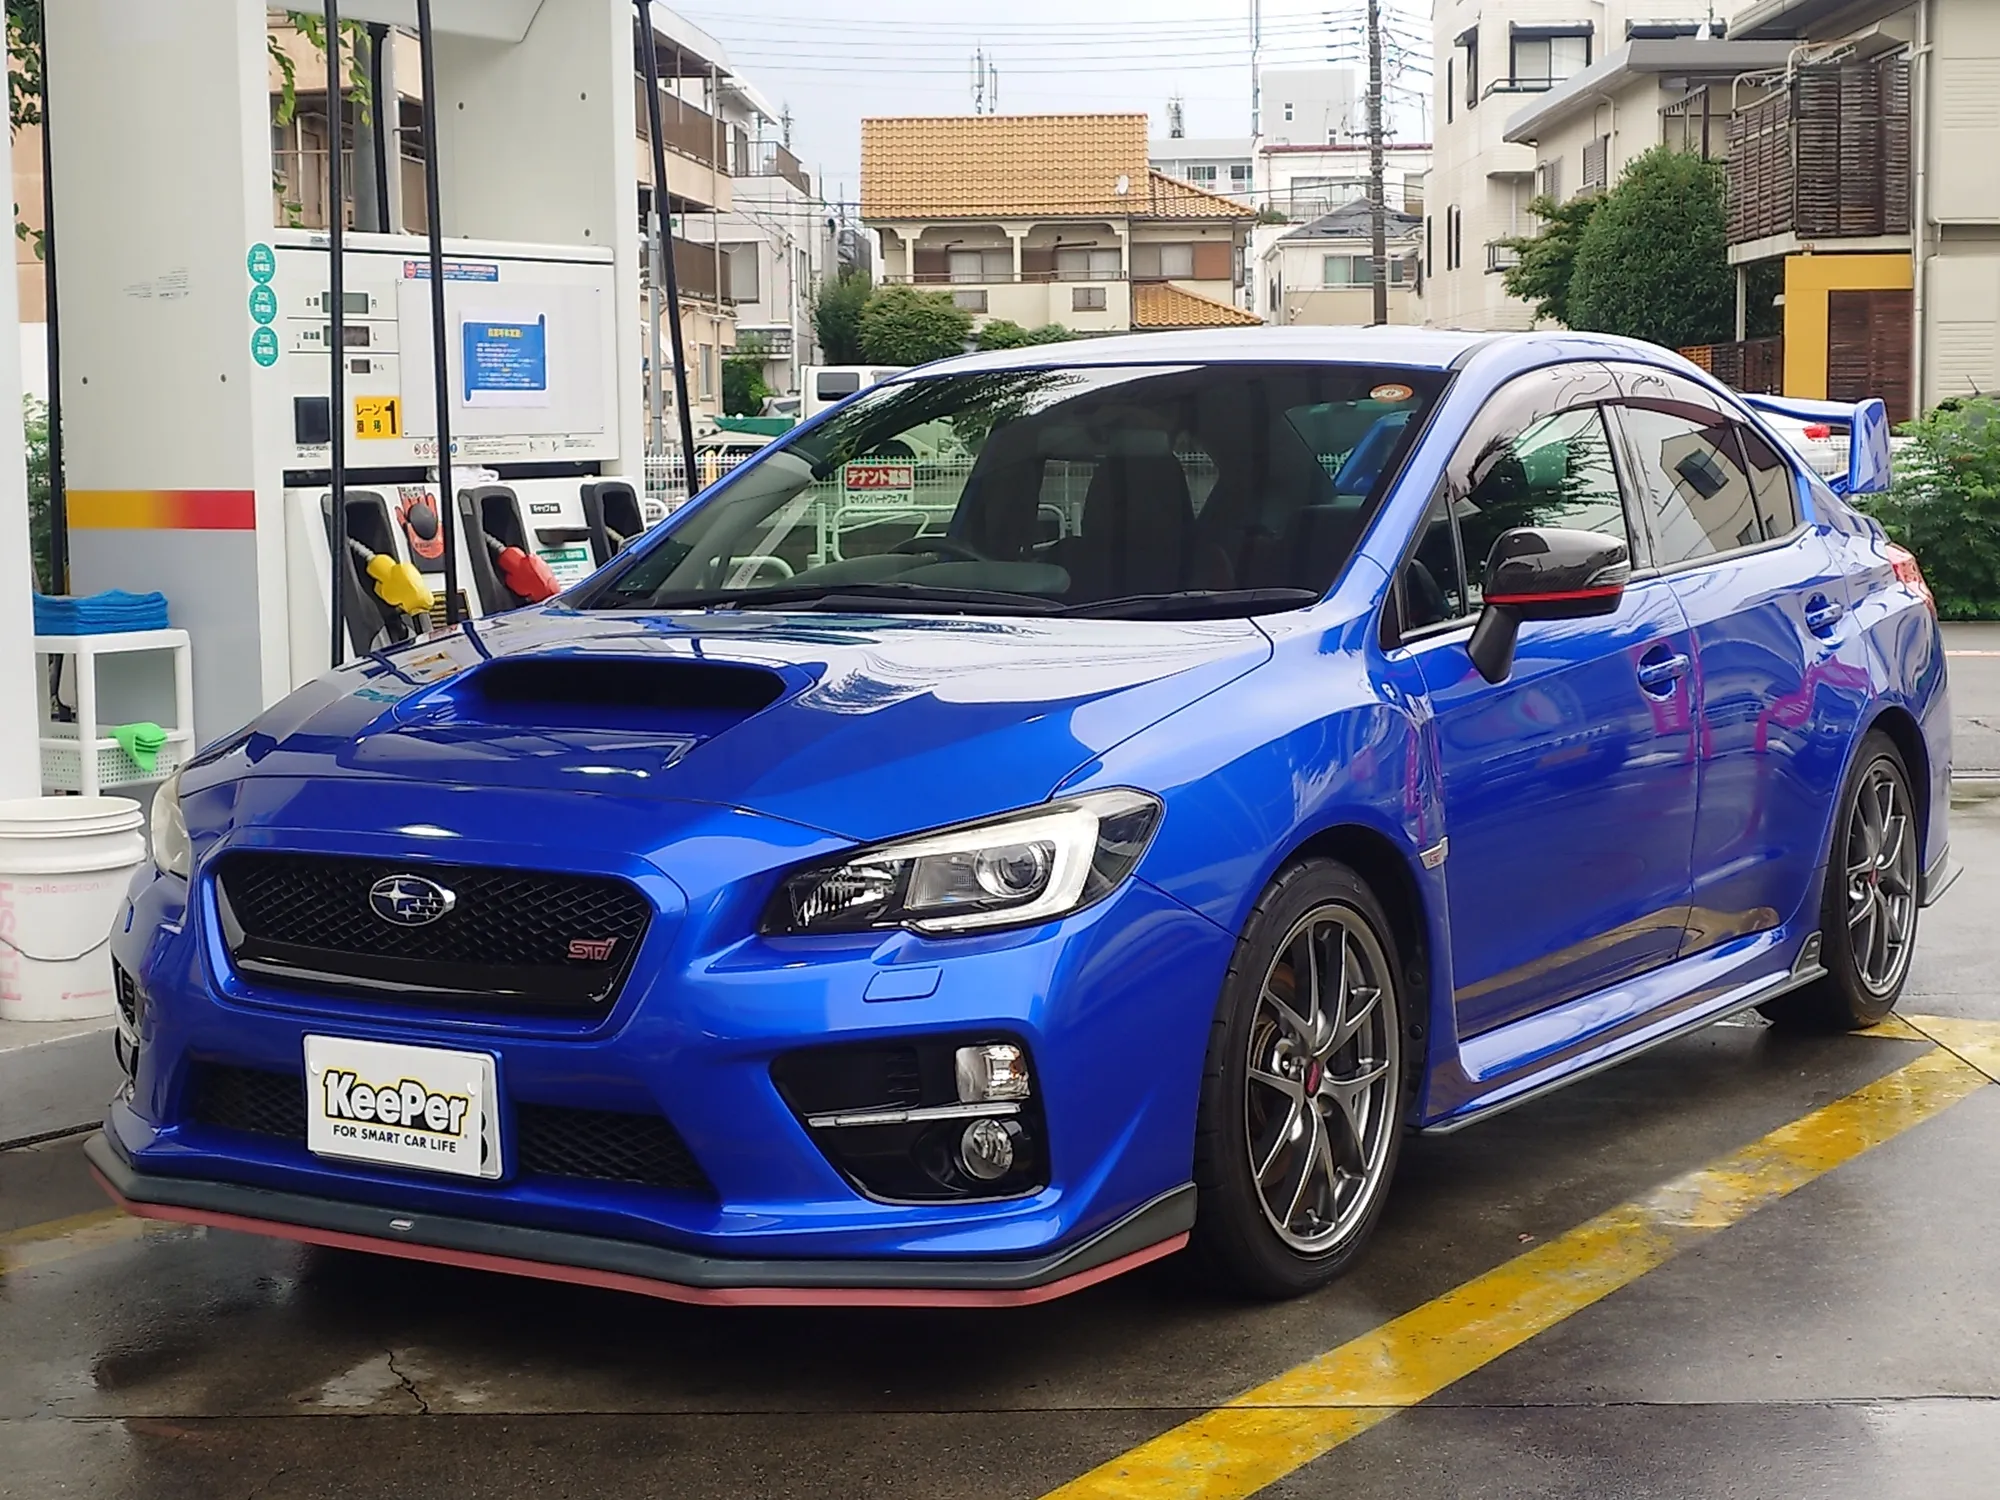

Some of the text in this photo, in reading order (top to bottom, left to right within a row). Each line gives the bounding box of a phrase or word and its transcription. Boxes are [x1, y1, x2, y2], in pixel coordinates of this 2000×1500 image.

[356, 404, 381, 415] レーン
[384, 400, 396, 434] 1
[323, 1069, 469, 1136] KeePer
[333, 1124, 457, 1153] FOR SMART CAR LIFE
